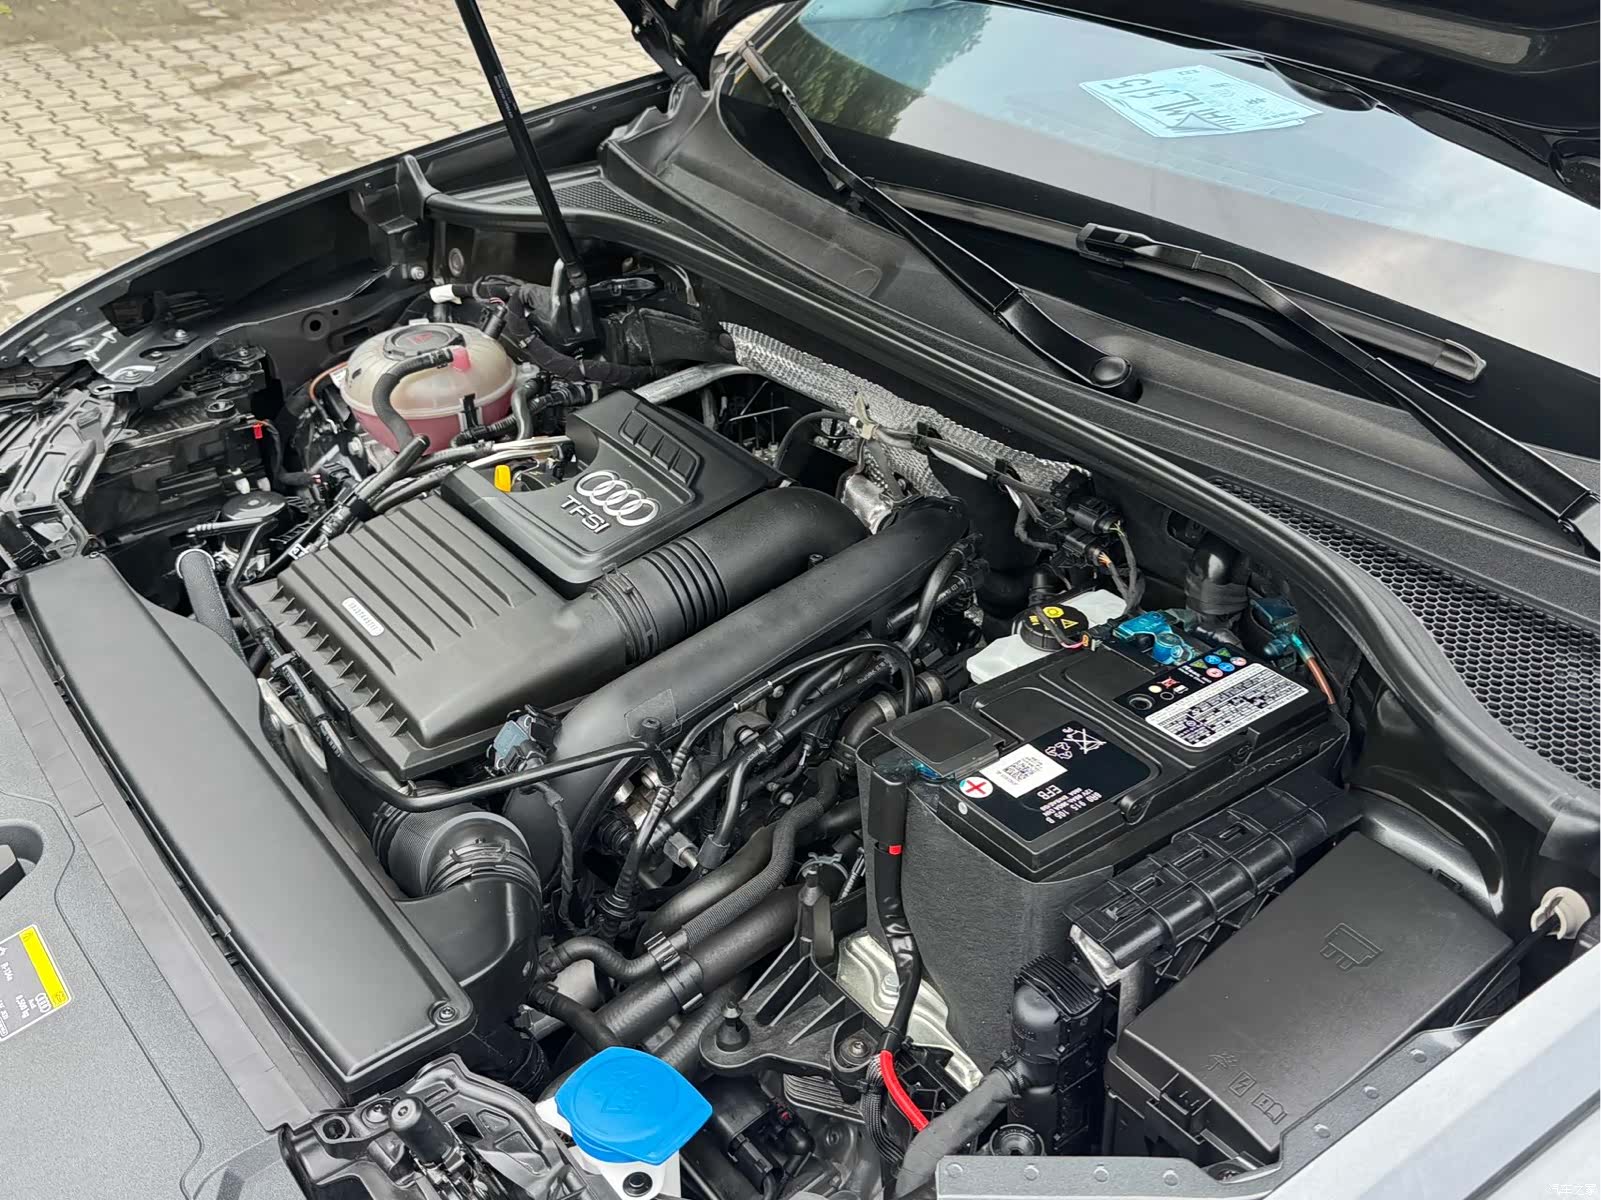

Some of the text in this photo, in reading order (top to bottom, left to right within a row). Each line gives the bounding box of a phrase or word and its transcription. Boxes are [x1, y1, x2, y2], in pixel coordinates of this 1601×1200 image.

[560, 494, 610, 534] TFSI
[1036, 784, 1063, 800] EFB
[1070, 800, 1087, 811] 915
[1054, 809, 1070, 819] 105
